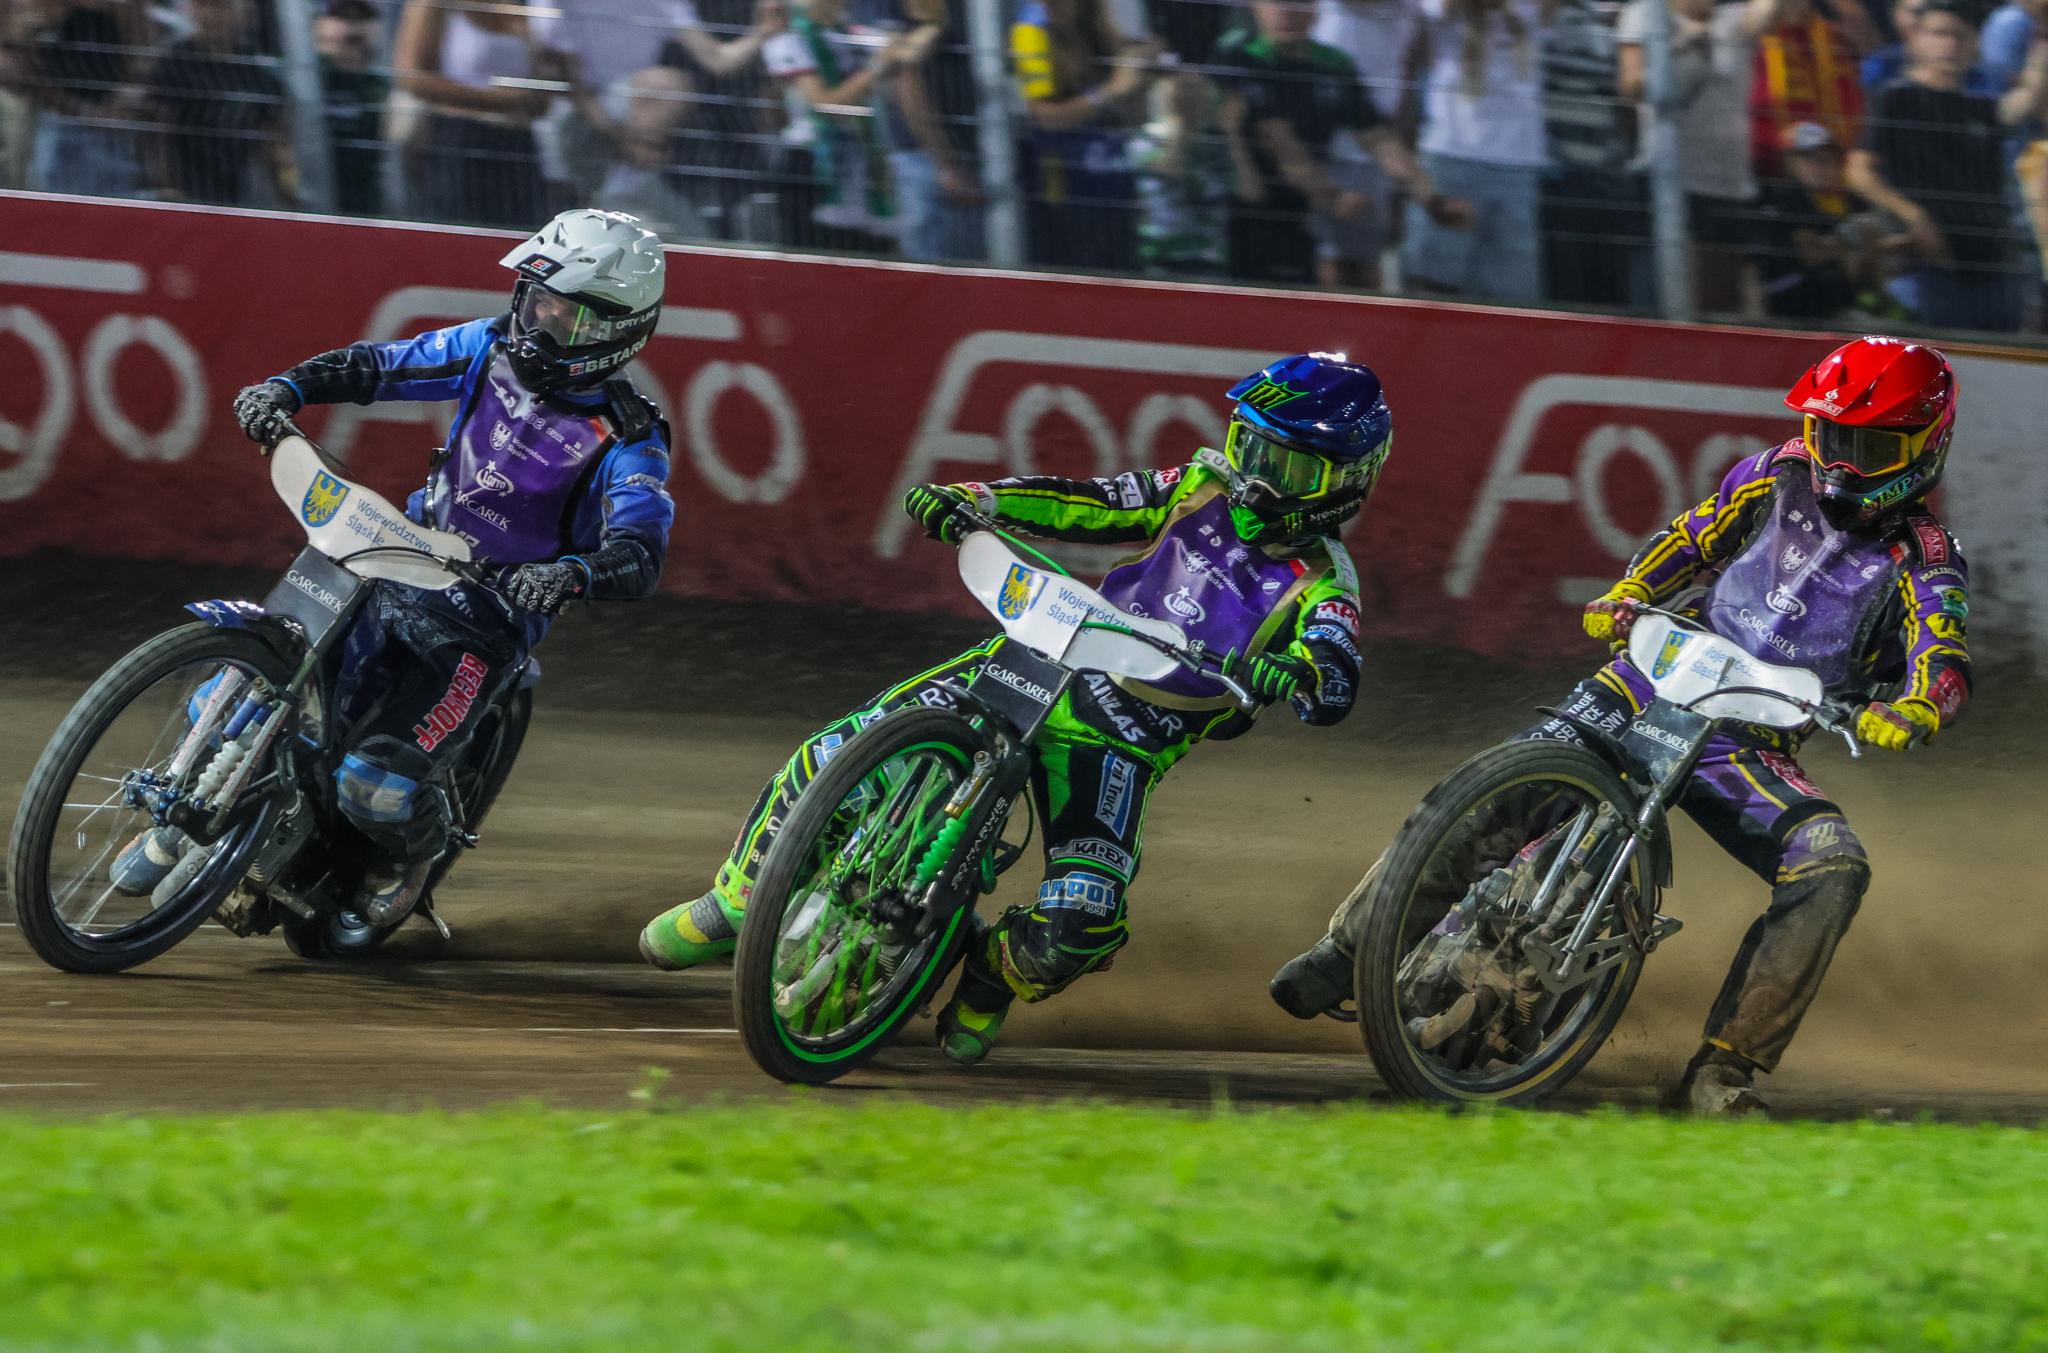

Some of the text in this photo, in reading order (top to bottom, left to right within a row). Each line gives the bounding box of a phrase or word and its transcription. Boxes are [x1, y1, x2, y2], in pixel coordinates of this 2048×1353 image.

[482, 470, 507, 490] LOTTO
[356, 497, 432, 554] Województwo
[454, 486, 512, 530] ARCAREK
[345, 515, 386, 547] Śląskie
[286, 569, 346, 613] GARCAREK
[1171, 595, 1198, 617] LOTTO
[1772, 593, 1799, 613] LOTTO
[1739, 608, 1800, 659] GARCAREK
[986, 664, 1054, 703] GARCAREK
[413, 651, 489, 753] BECKHOFF
[1632, 719, 1692, 752] GARCAREK
[1100, 784, 1124, 822] Truck
[1074, 841, 1125, 868] KAREX
[1084, 902, 1107, 917] 1991
